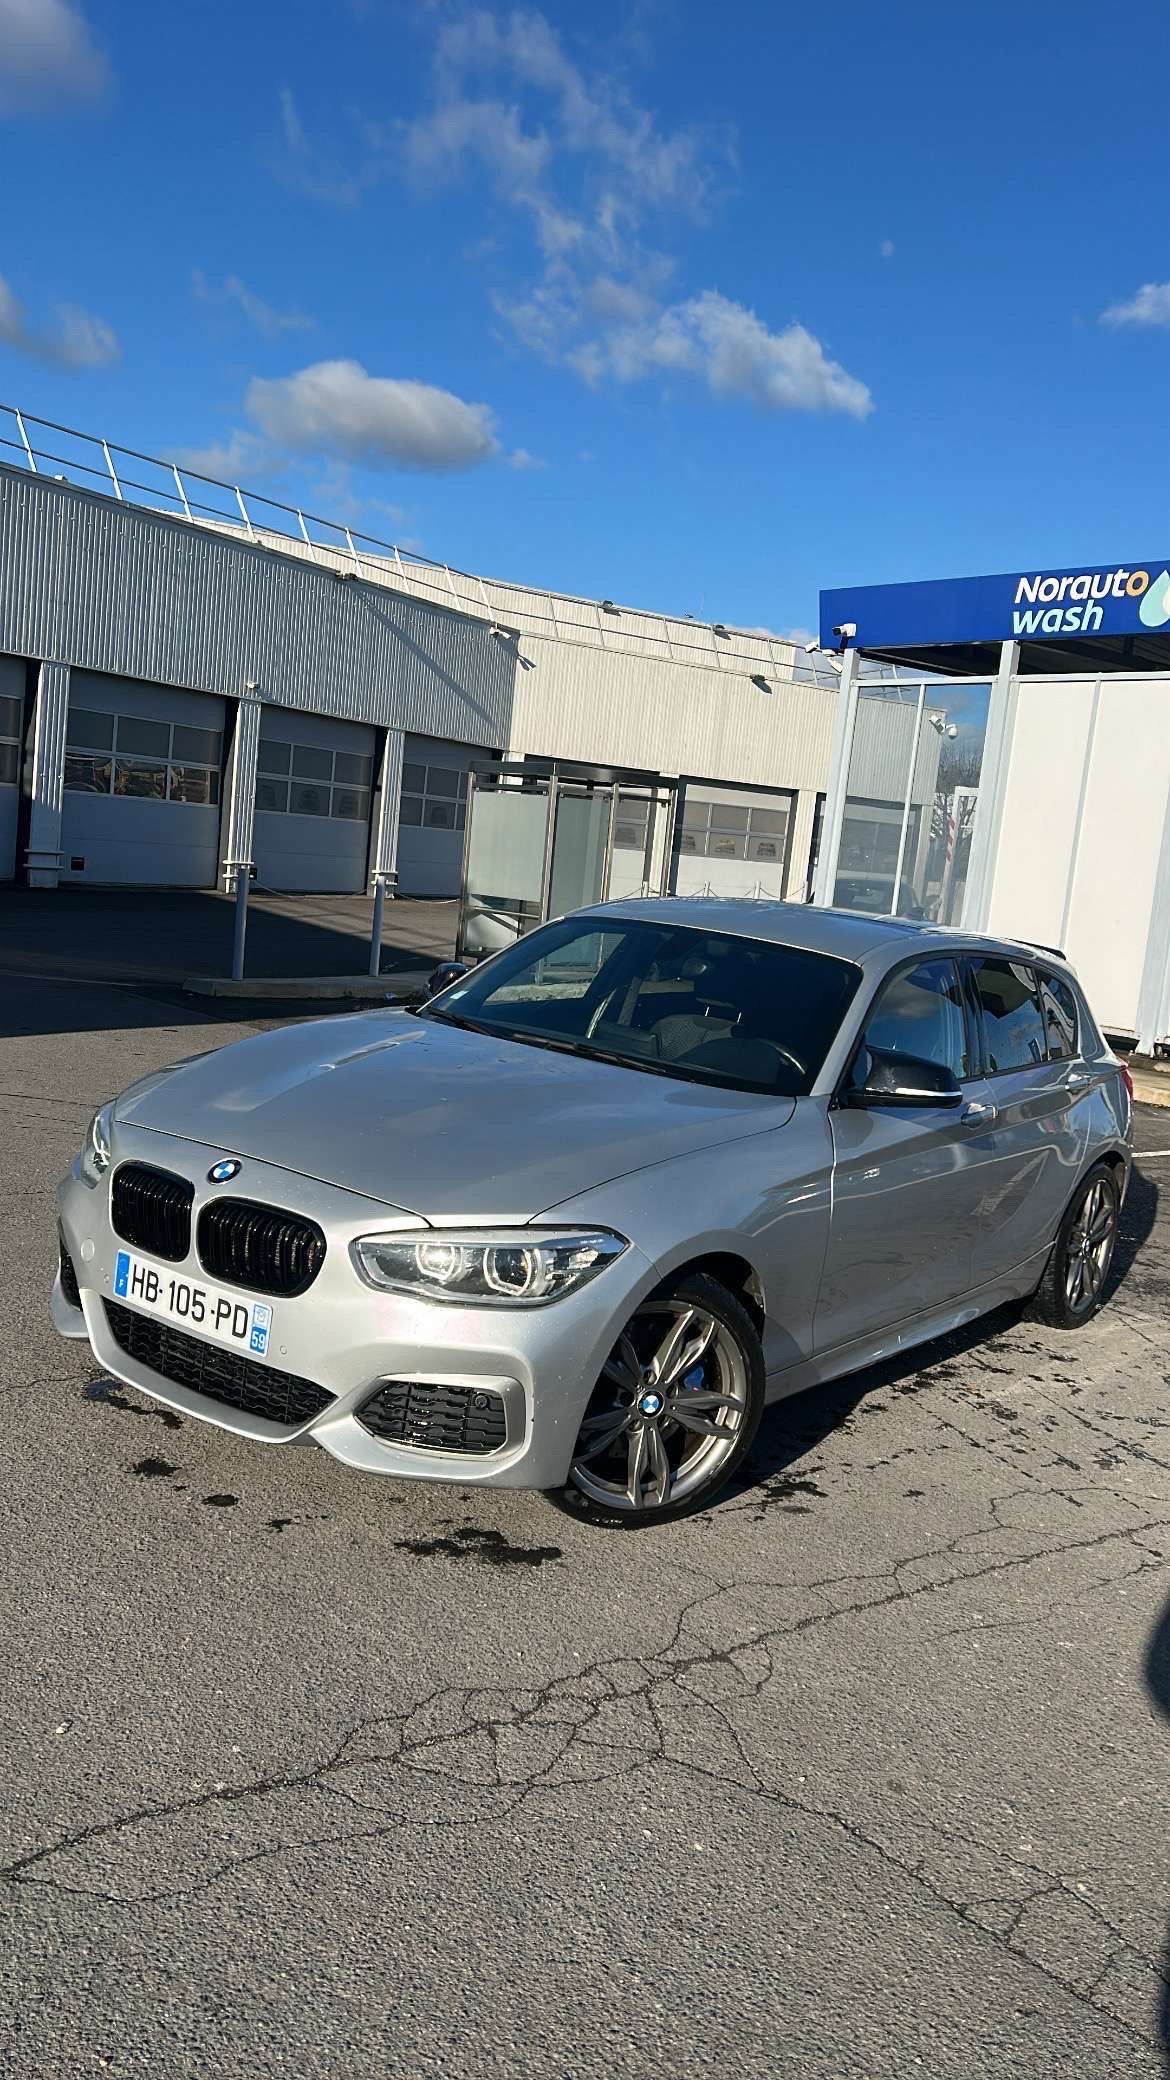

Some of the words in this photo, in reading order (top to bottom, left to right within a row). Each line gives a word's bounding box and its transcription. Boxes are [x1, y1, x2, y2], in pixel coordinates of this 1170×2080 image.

[1014, 568, 1149, 604] Norauto
[1012, 600, 1104, 634] wash
[131, 1264, 249, 1339] HB-105-PD
[251, 1331, 266, 1350] 59
